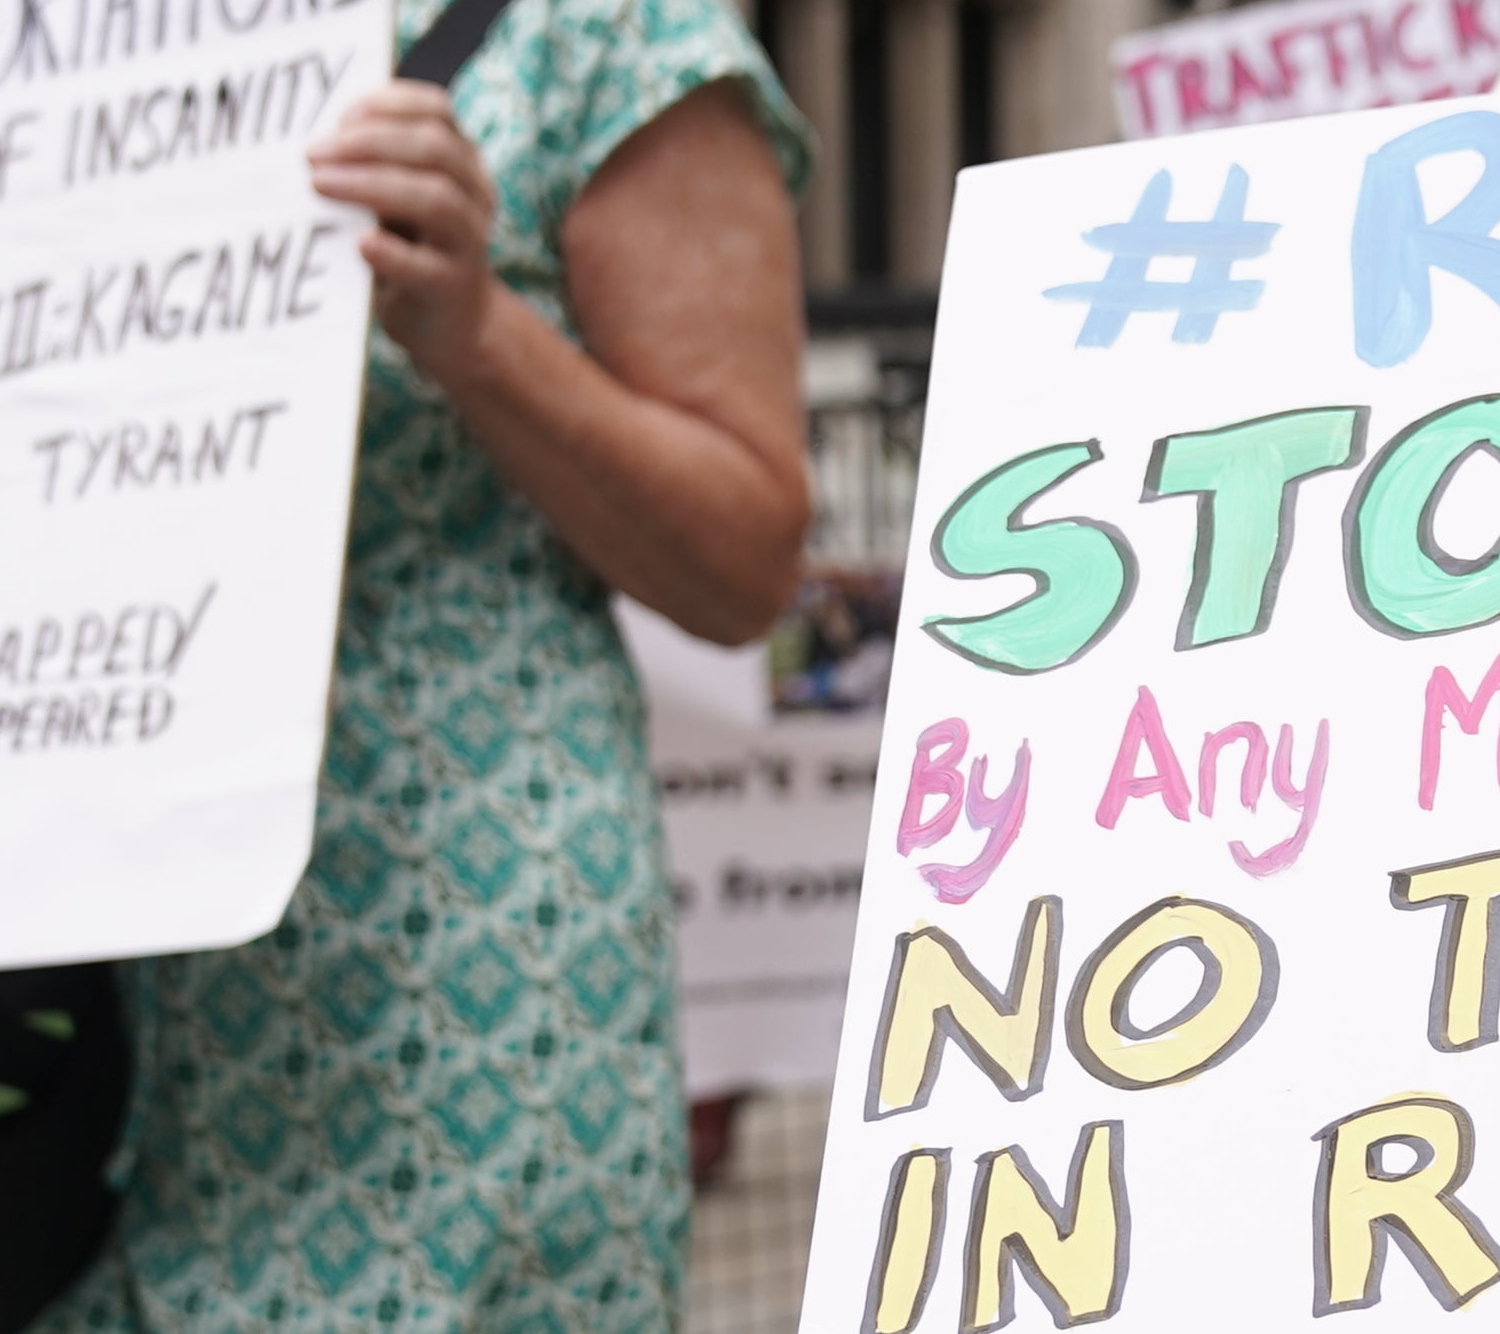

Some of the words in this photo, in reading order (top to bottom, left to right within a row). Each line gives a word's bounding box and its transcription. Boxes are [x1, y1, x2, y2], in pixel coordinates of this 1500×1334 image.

[61, 45, 358, 187] INSANITY
[30, 400, 290, 507] TYRANT
[897, 714, 1032, 905] By
[1095, 683, 1331, 878] Any
[864, 893, 1282, 1121] NO
